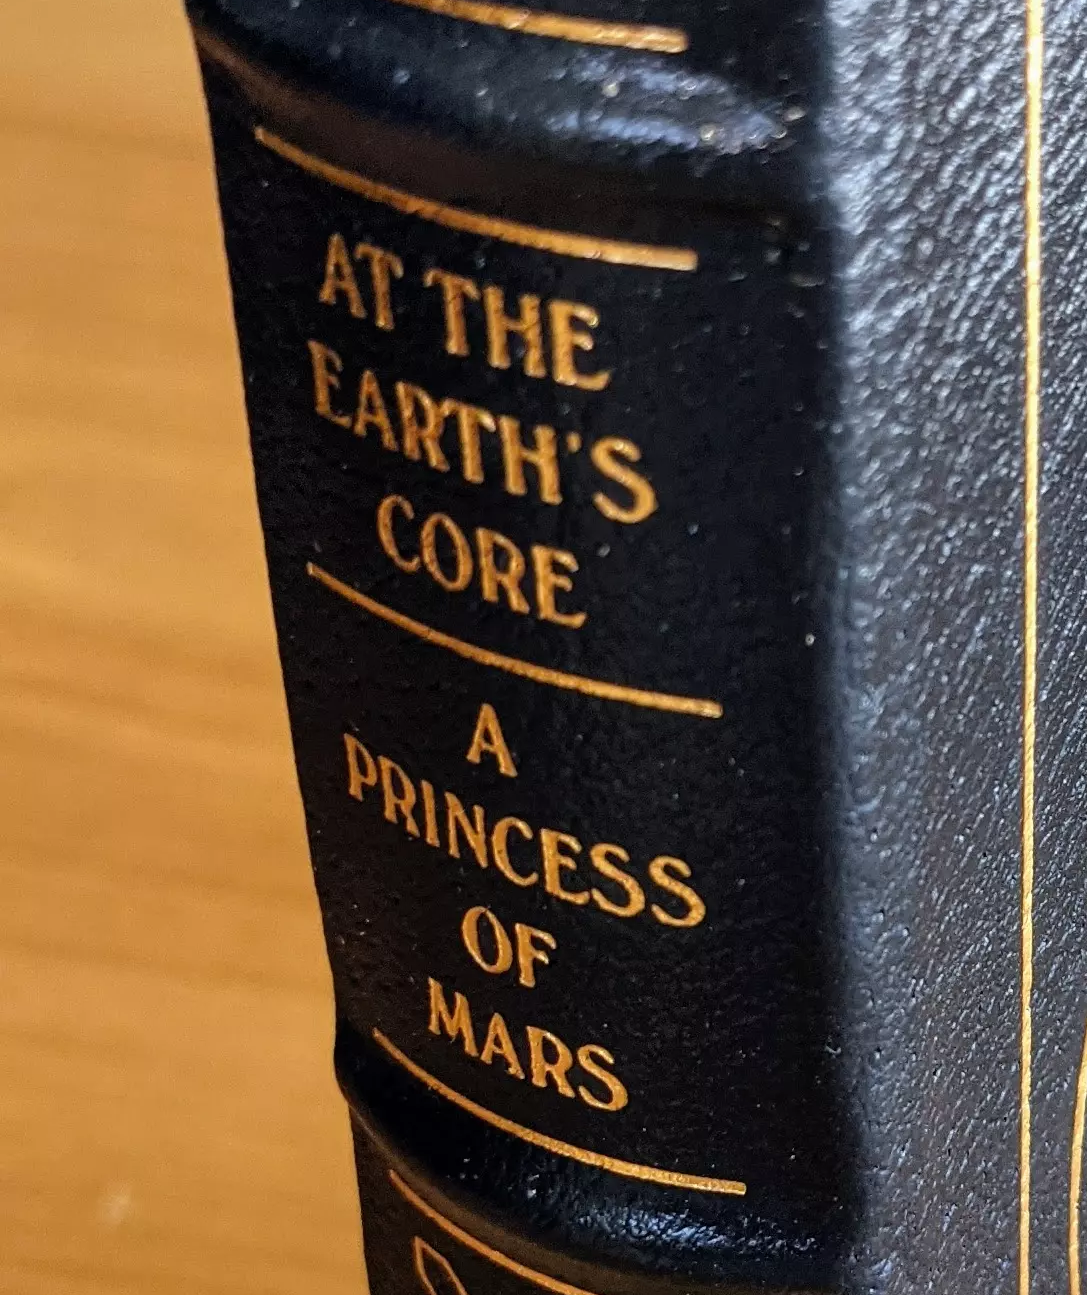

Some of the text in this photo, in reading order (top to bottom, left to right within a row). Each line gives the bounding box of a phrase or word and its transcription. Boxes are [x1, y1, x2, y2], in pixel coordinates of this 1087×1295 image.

[318, 232, 612, 391] AT THE
[307, 339, 659, 524] EARTH'S
[376, 494, 588, 629] CORE
[465, 702, 518, 778] A
[343, 732, 706, 929] PRINCESS
[461, 905, 557, 988] OF
[428, 977, 629, 1112] MARS
